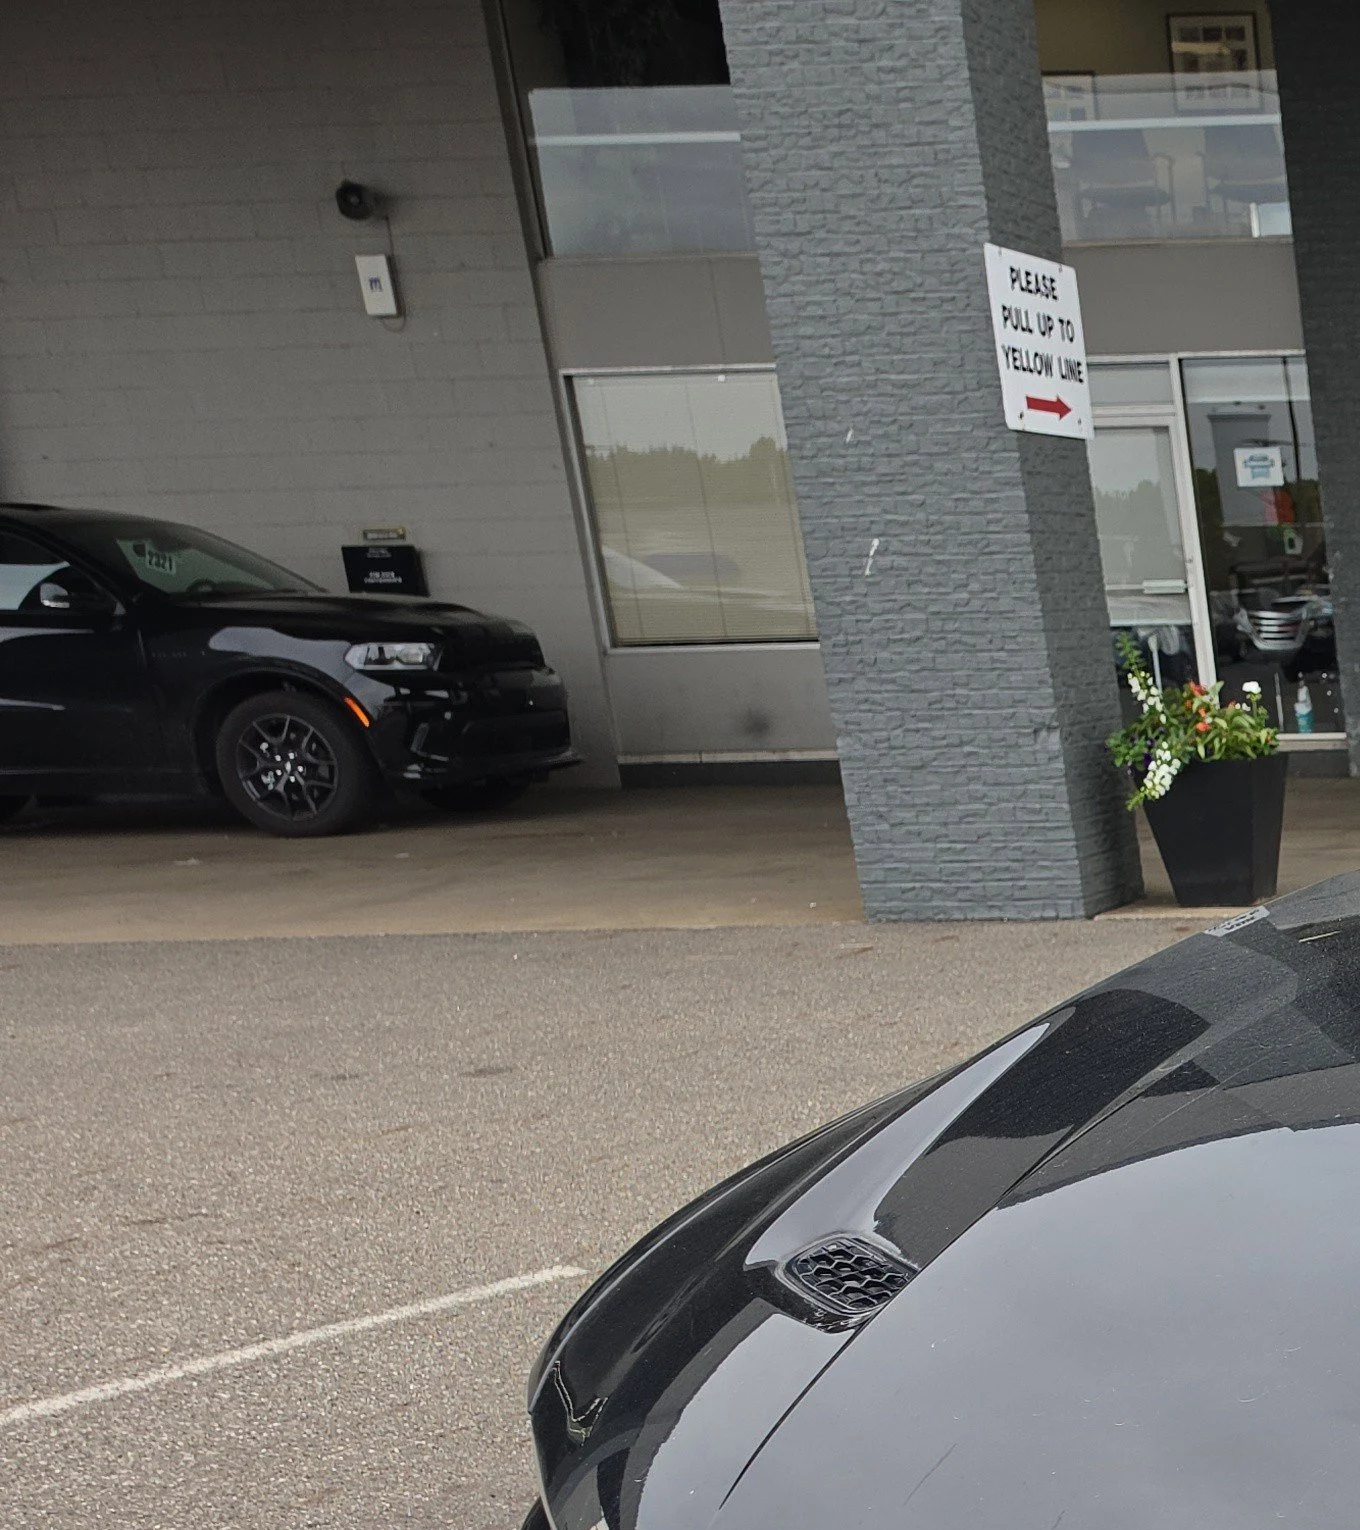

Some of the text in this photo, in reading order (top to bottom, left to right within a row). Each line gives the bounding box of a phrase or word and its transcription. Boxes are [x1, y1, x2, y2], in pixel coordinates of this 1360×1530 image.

[1009, 266, 1059, 301] PLEASE
[1002, 305, 1075, 343] PULL UP TO
[1001, 343, 1084, 383] YELLOW LINE
